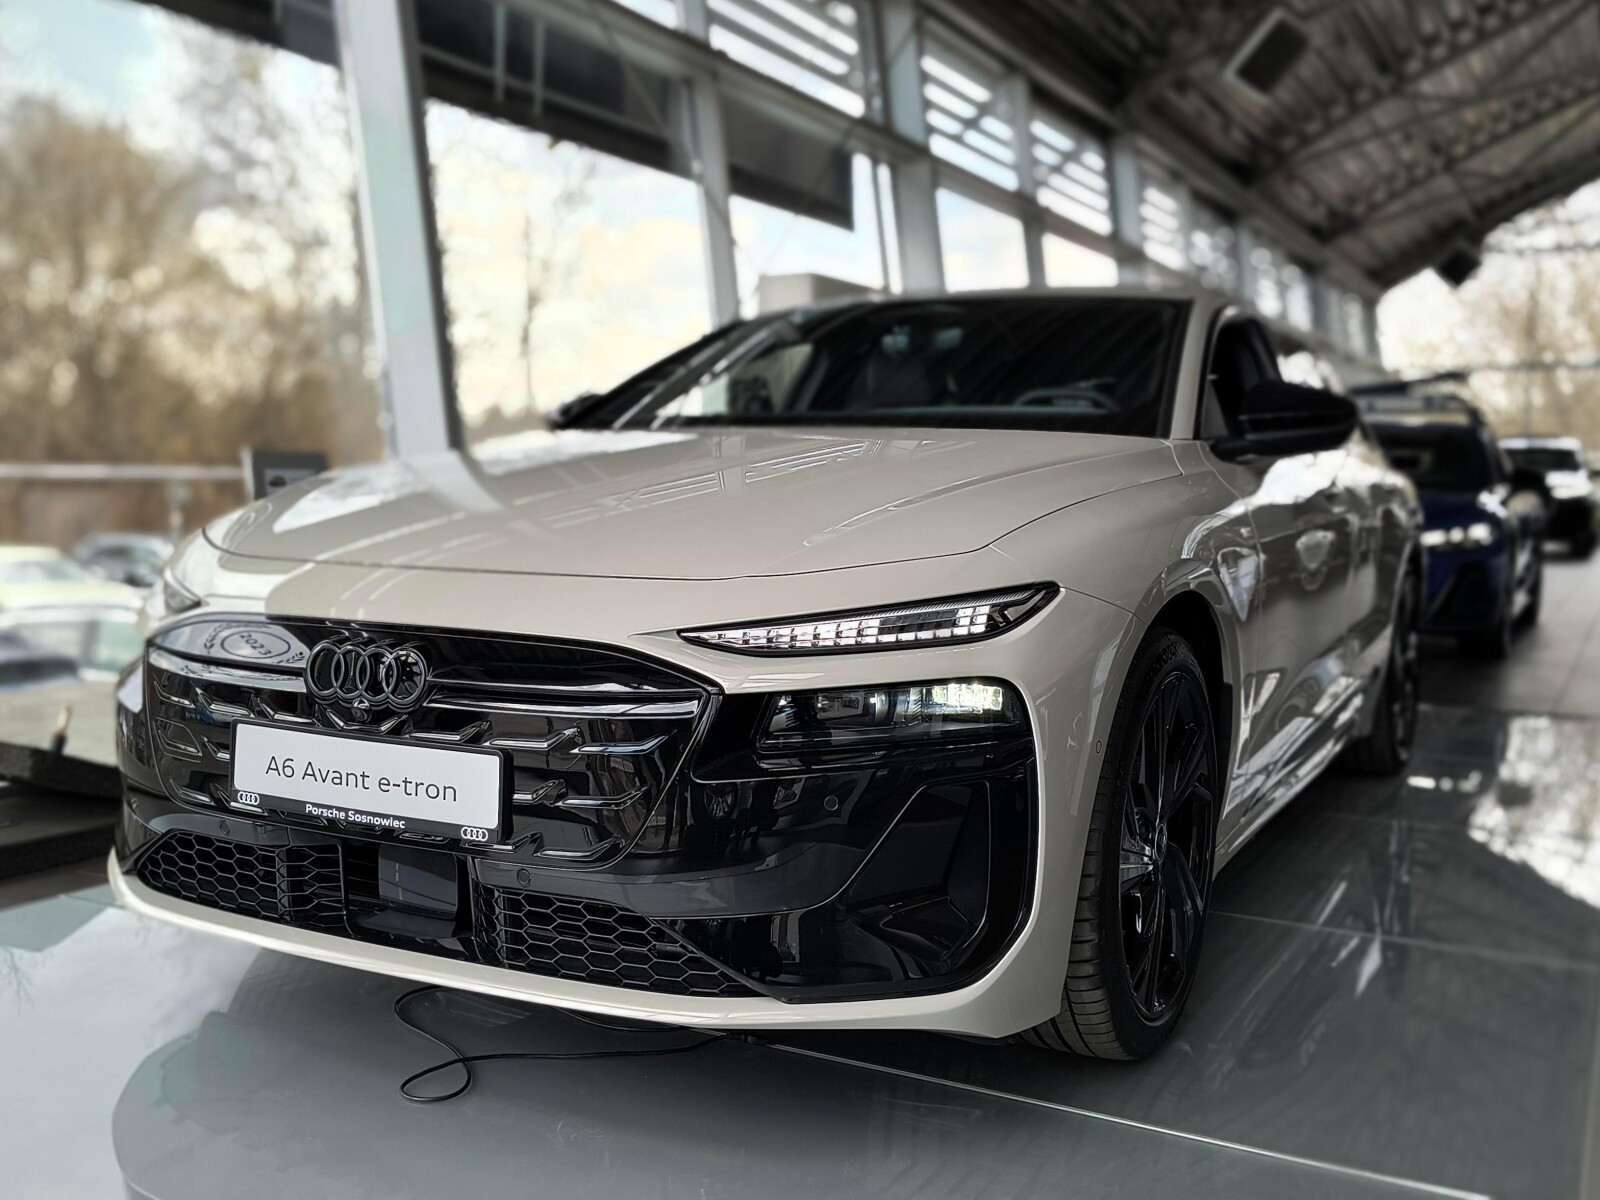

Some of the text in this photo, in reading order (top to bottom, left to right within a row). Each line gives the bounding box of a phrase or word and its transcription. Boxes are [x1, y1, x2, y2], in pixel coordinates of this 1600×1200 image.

[239, 633, 272, 655] 2023
[265, 756, 457, 802] A6 Avant e-tron
[306, 804, 405, 829] Porsche Sosnowiec
